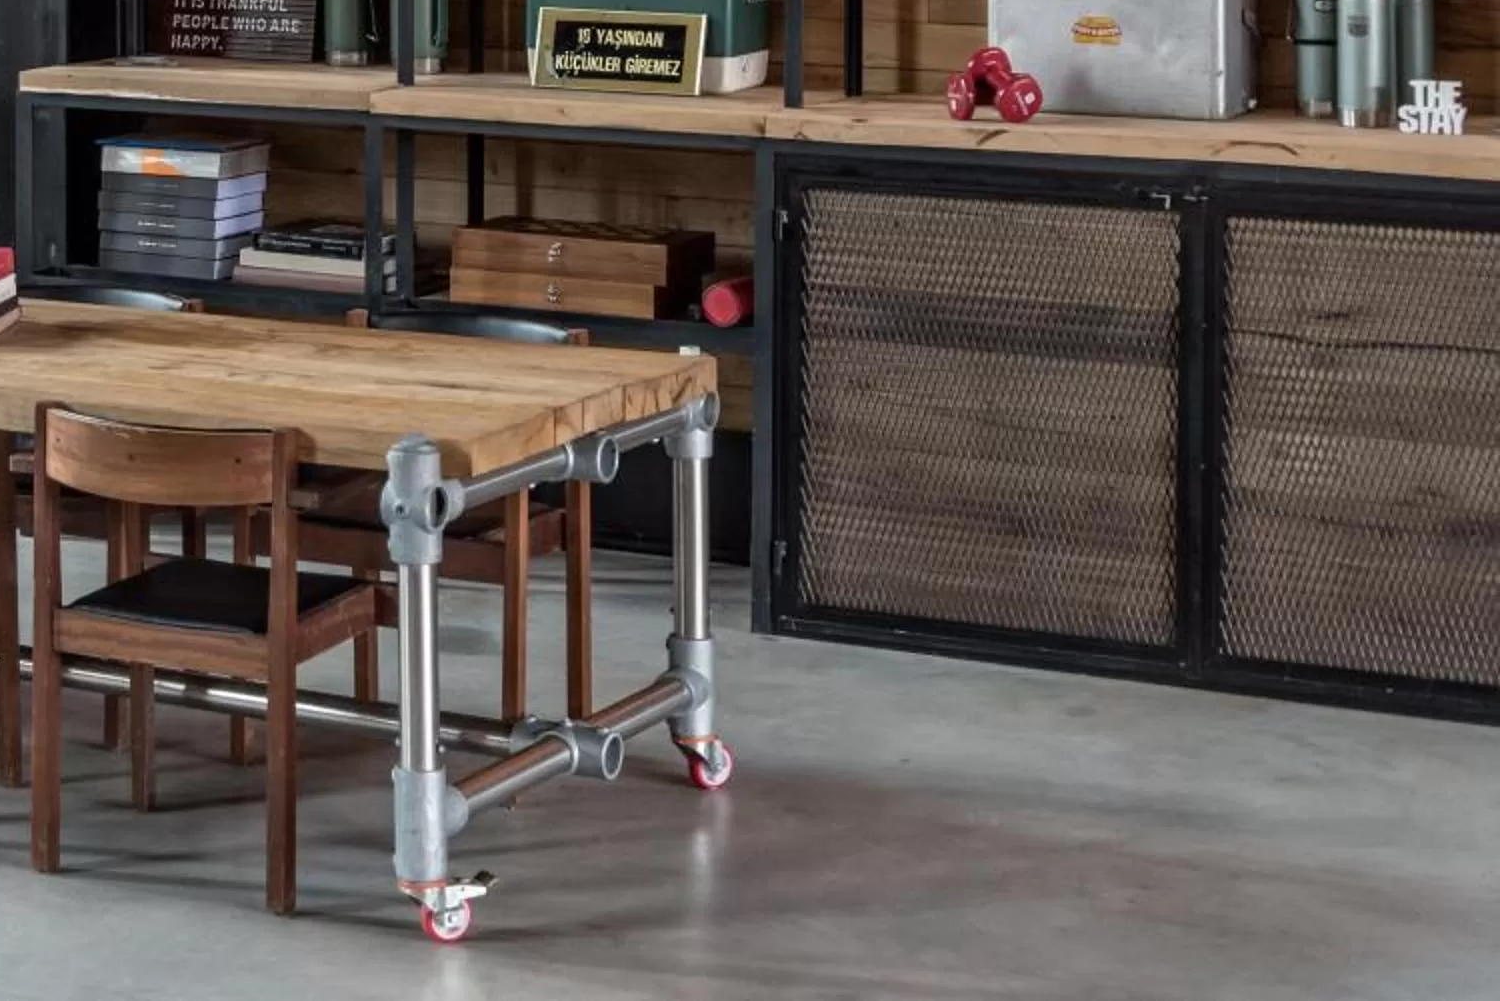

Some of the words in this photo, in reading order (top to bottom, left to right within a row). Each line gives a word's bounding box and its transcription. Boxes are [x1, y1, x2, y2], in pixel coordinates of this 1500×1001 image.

[172, 13, 230, 30] PEOPLE
[232, 15, 267, 32] WHO
[269, 18, 302, 34] ARE
[170, 33, 223, 51] HAPPY.
[596, 28, 665, 50] YAŞINDAN
[555, 50, 621, 76] KÜÇÜKLER
[1408, 79, 1463, 107] THE
[1398, 104, 1467, 135] STAY
